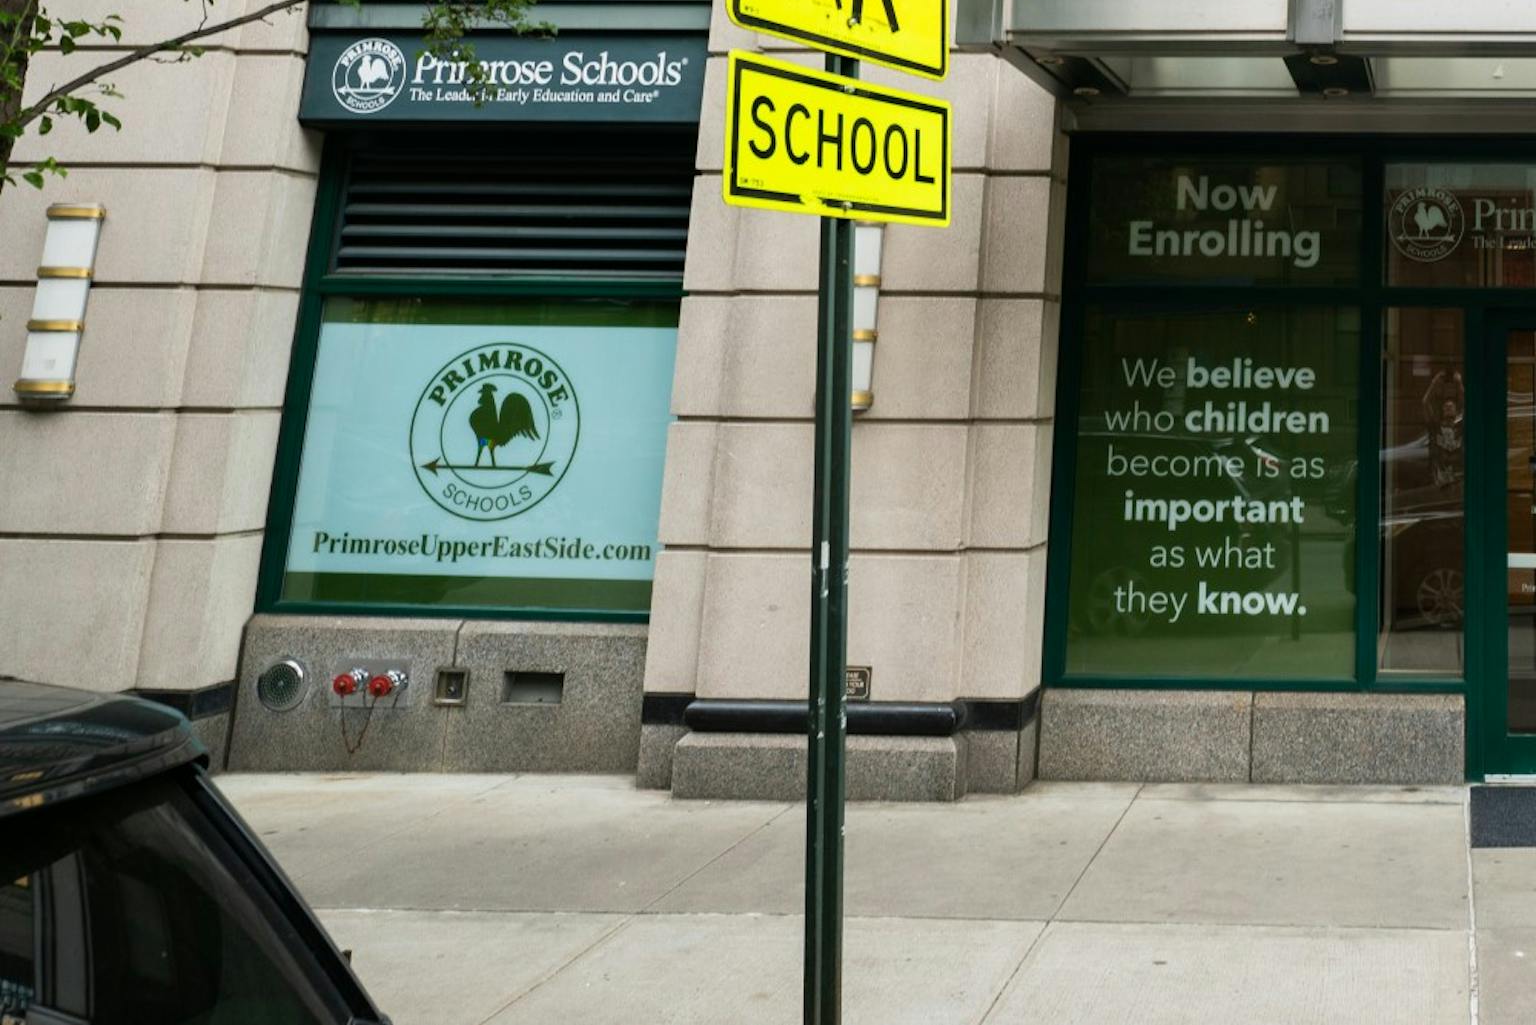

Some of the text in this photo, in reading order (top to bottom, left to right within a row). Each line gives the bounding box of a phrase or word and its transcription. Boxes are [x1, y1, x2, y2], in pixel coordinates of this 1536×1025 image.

[340, 41, 402, 67] PRIMROSE
[410, 88, 433, 102] The
[436, 88, 478, 102] Lead
[497, 88, 529, 105] Early
[533, 88, 595, 103] Education
[597, 89, 622, 103] and
[748, 95, 935, 184] SCHOOL
[1177, 175, 1278, 211] Now
[1128, 219, 1321, 268] Enrolling
[1472, 236, 1496, 250] The
[428, 350, 569, 409] PRIMROSE
[1122, 357, 1316, 389] We believe
[1104, 400, 1329, 433] who children
[1107, 444, 1325, 478] become is as
[442, 482, 533, 513] SCHOOLS
[1124, 489, 1305, 531] important
[312, 531, 651, 563] PrimroseUpperEastSide.com
[1150, 536, 1276, 569] as what
[1114, 580, 1307, 624] they know.
